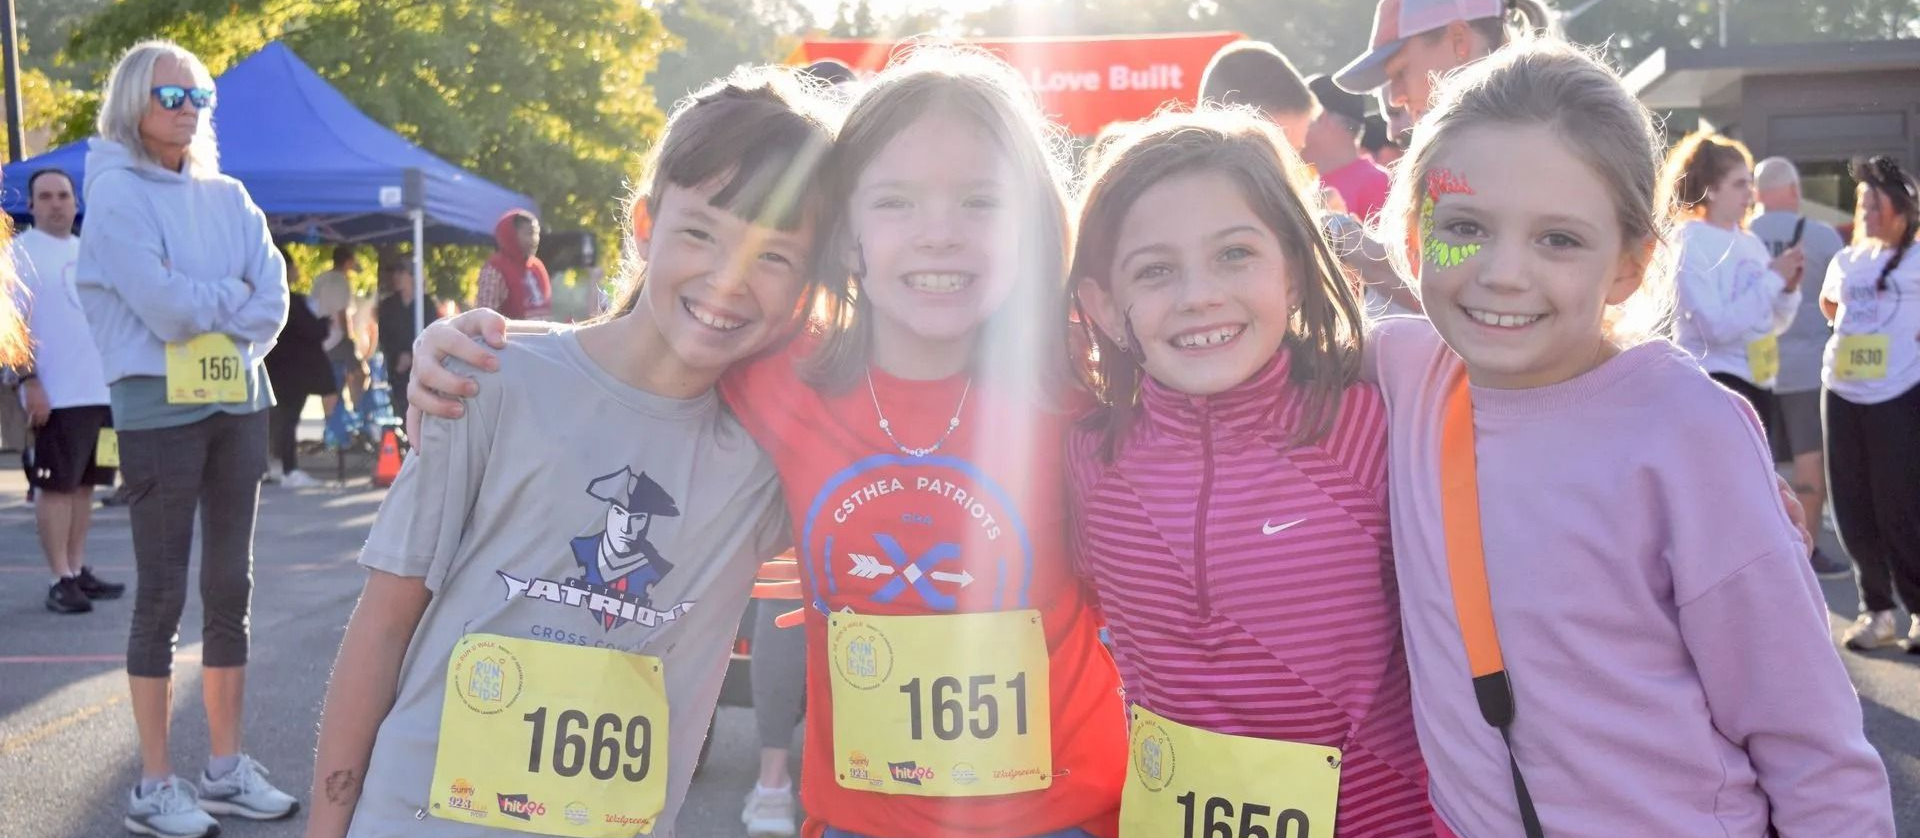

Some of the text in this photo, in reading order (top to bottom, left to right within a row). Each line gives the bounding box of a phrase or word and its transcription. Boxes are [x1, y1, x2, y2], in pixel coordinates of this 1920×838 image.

[1032, 63, 1184, 91] Love Built
[198, 355, 240, 382] 1567
[833, 476, 1002, 540] CSTHEA PATRIOTS
[530, 624, 588, 646] CROSS
[475, 660, 501, 678] RUN
[899, 671, 1028, 741] 1651
[522, 706, 653, 783] 1669
[449, 785, 476, 797] Sunny
